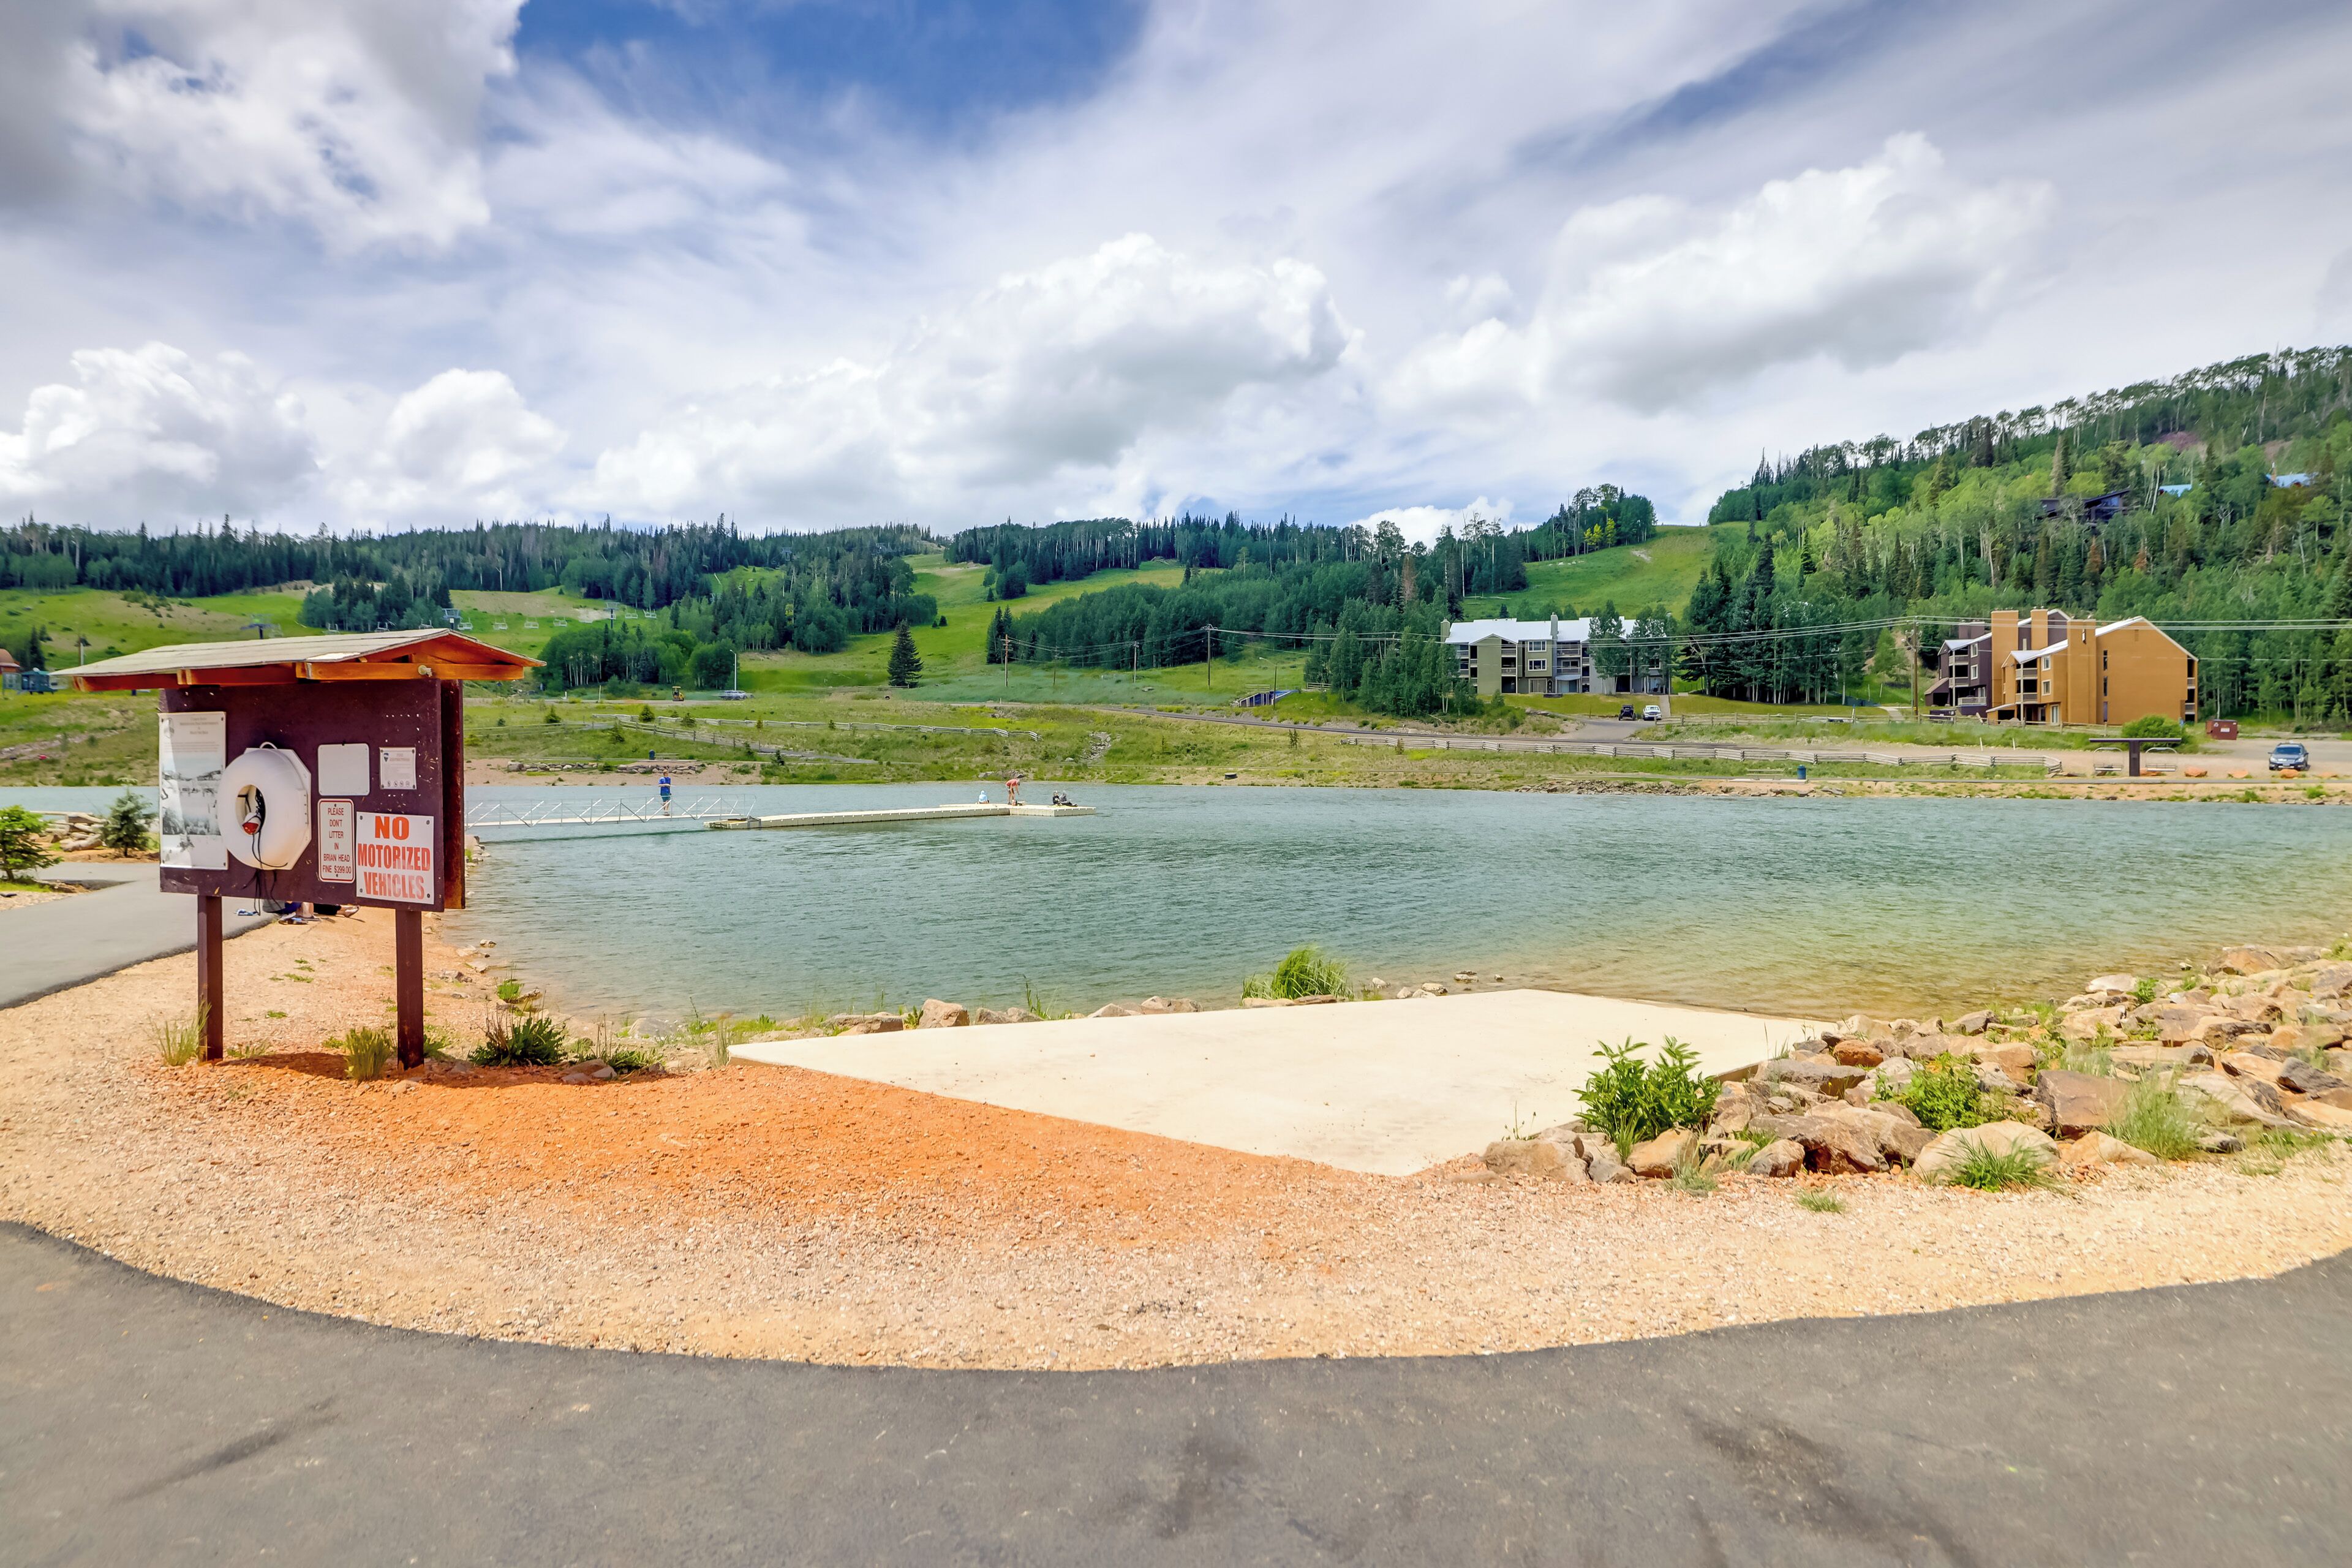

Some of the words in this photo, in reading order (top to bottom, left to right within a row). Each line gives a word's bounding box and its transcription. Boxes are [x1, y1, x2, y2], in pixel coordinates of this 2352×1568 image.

[375, 816, 409, 840] NO
[338, 854, 350, 862] HEAD
[358, 843, 431, 871] MOTORIZED
[363, 872, 425, 900] VEHICLES
